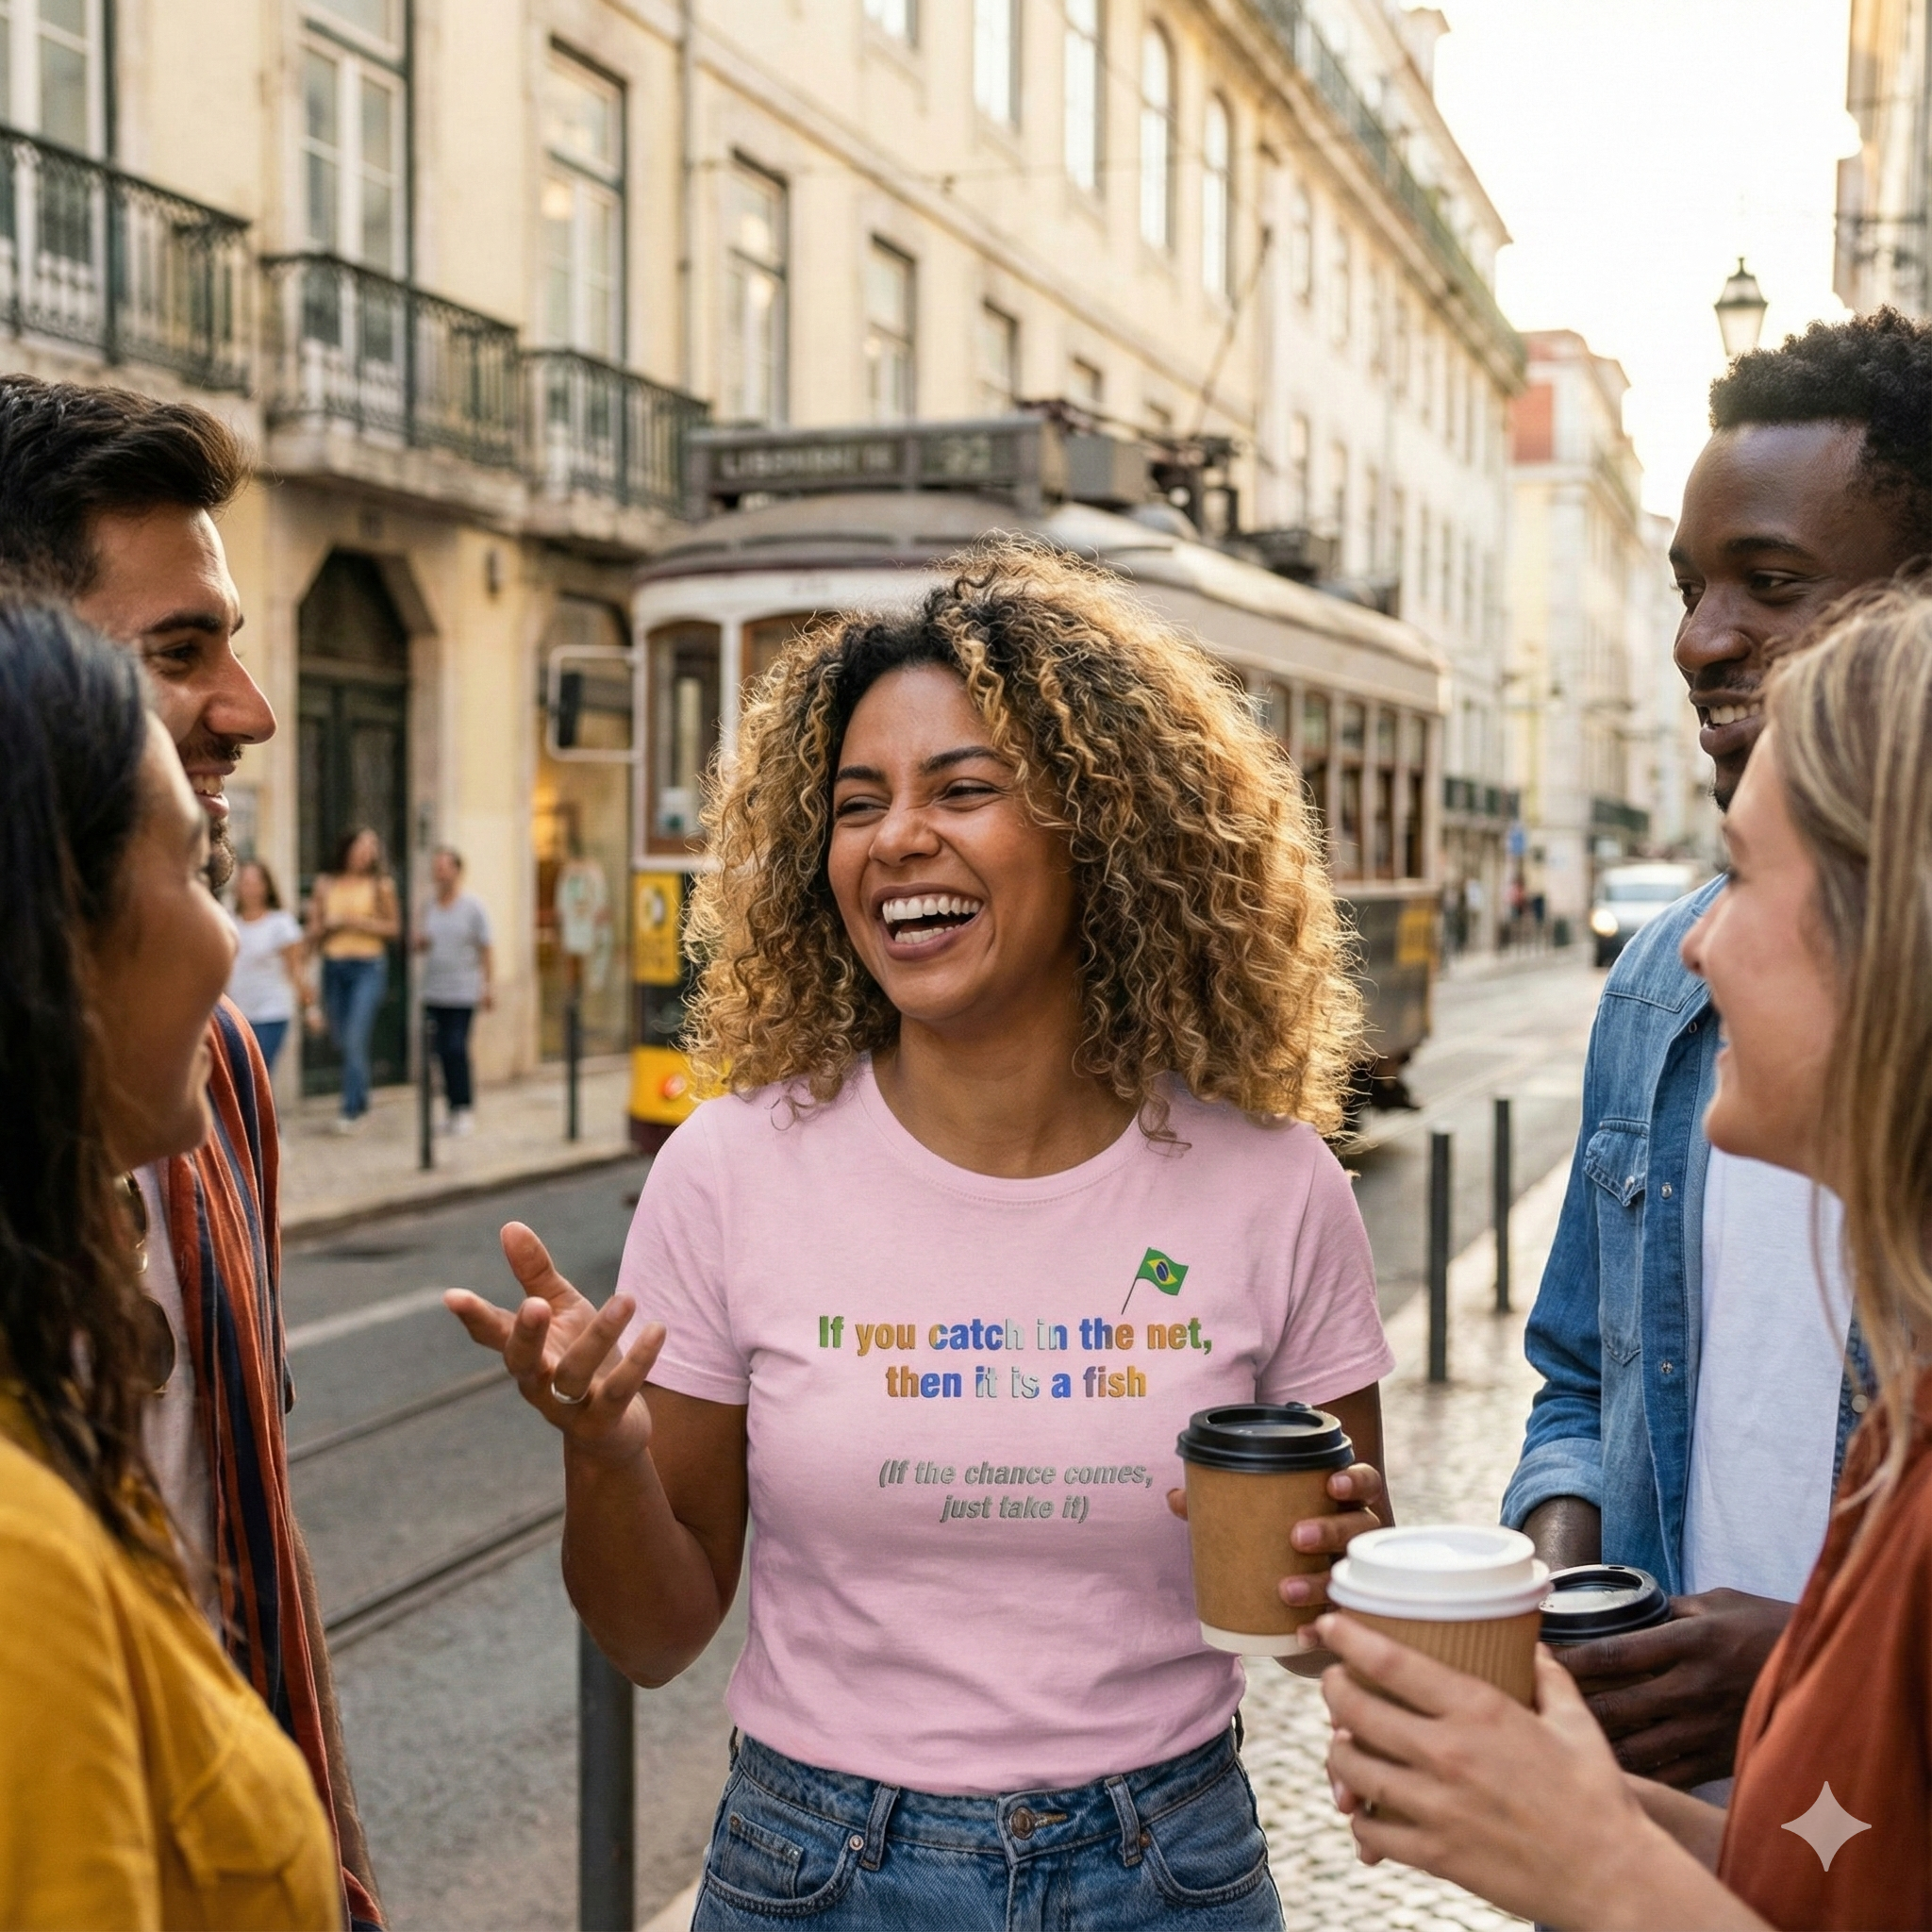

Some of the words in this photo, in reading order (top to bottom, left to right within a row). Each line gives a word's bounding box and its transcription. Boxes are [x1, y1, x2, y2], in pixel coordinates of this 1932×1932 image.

[819, 1315, 844, 1348] If
[855, 1323, 916, 1357] you
[928, 1318, 1024, 1350] catch
[1037, 1318, 1068, 1350] in
[1079, 1317, 1134, 1350] the
[1147, 1317, 1212, 1356] net,
[886, 1365, 962, 1398] then
[975, 1365, 998, 1398] it
[1010, 1365, 1040, 1399] is
[1051, 1373, 1072, 1398] a
[1083, 1365, 1147, 1398] fish
[878, 1458, 910, 1489] (If
[914, 1460, 957, 1485] the
[964, 1460, 1057, 1485] chance
[1064, 1464, 1153, 1489] comes,
[939, 1494, 993, 1524] just
[999, 1495, 1055, 1519] take
[1061, 1494, 1091, 1524] it)
